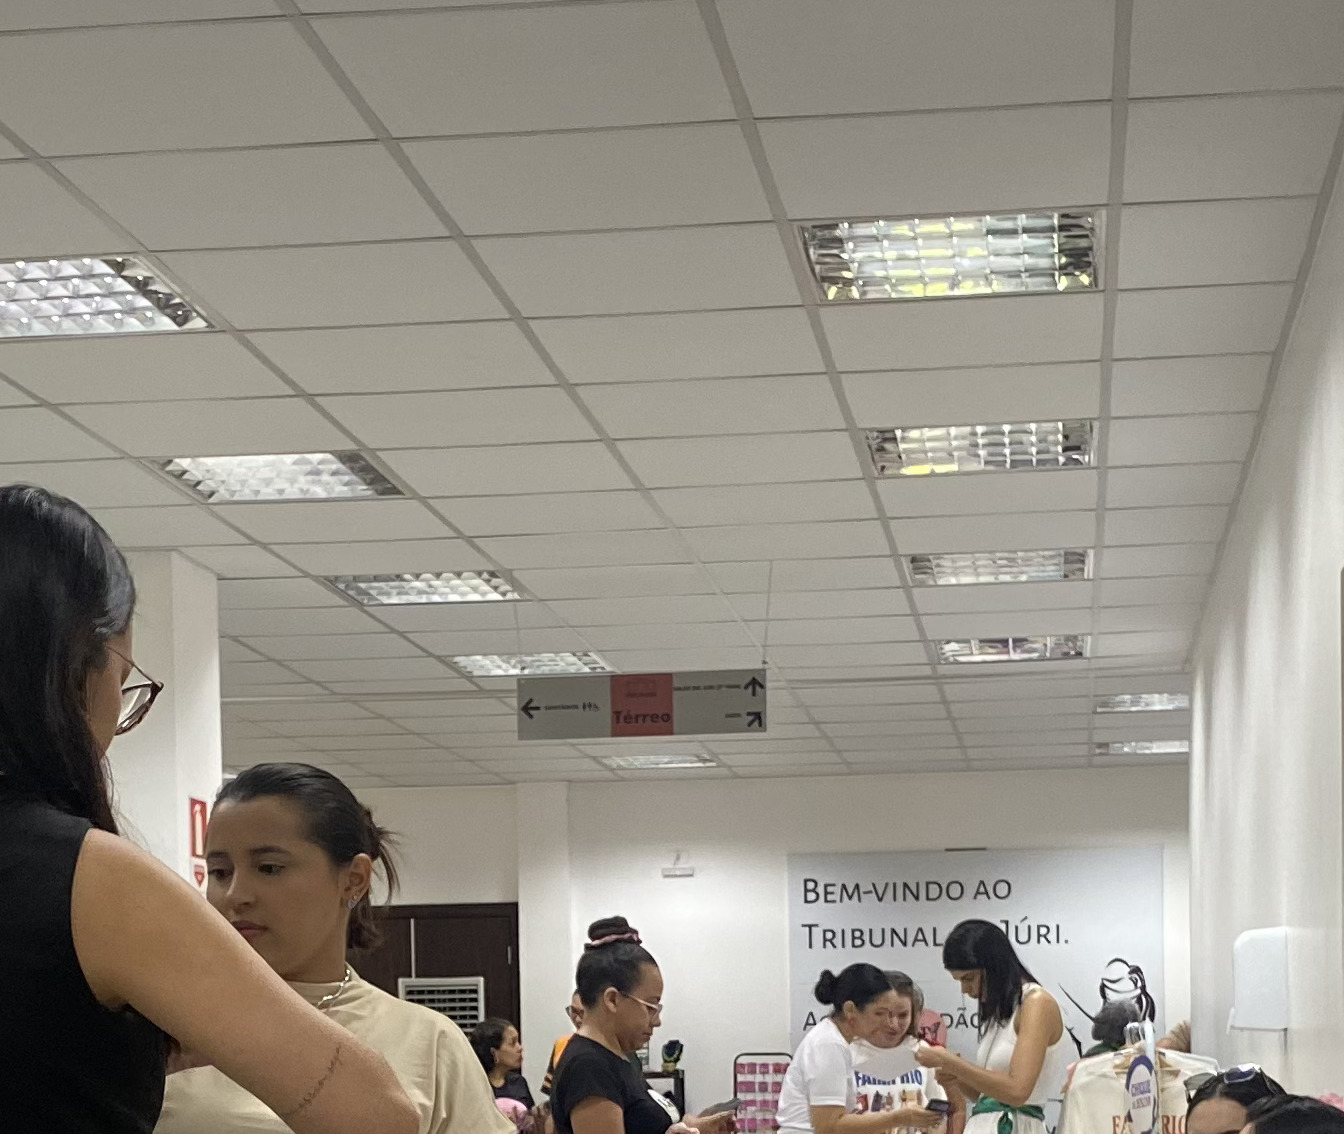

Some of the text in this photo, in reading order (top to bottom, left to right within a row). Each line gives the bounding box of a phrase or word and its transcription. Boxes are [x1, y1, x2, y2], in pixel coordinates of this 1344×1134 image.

[612, 709, 672, 725] Térreo
[803, 878, 1012, 904] BEM-VINDO AO
[801, 923, 943, 949] TRIBUNAL
